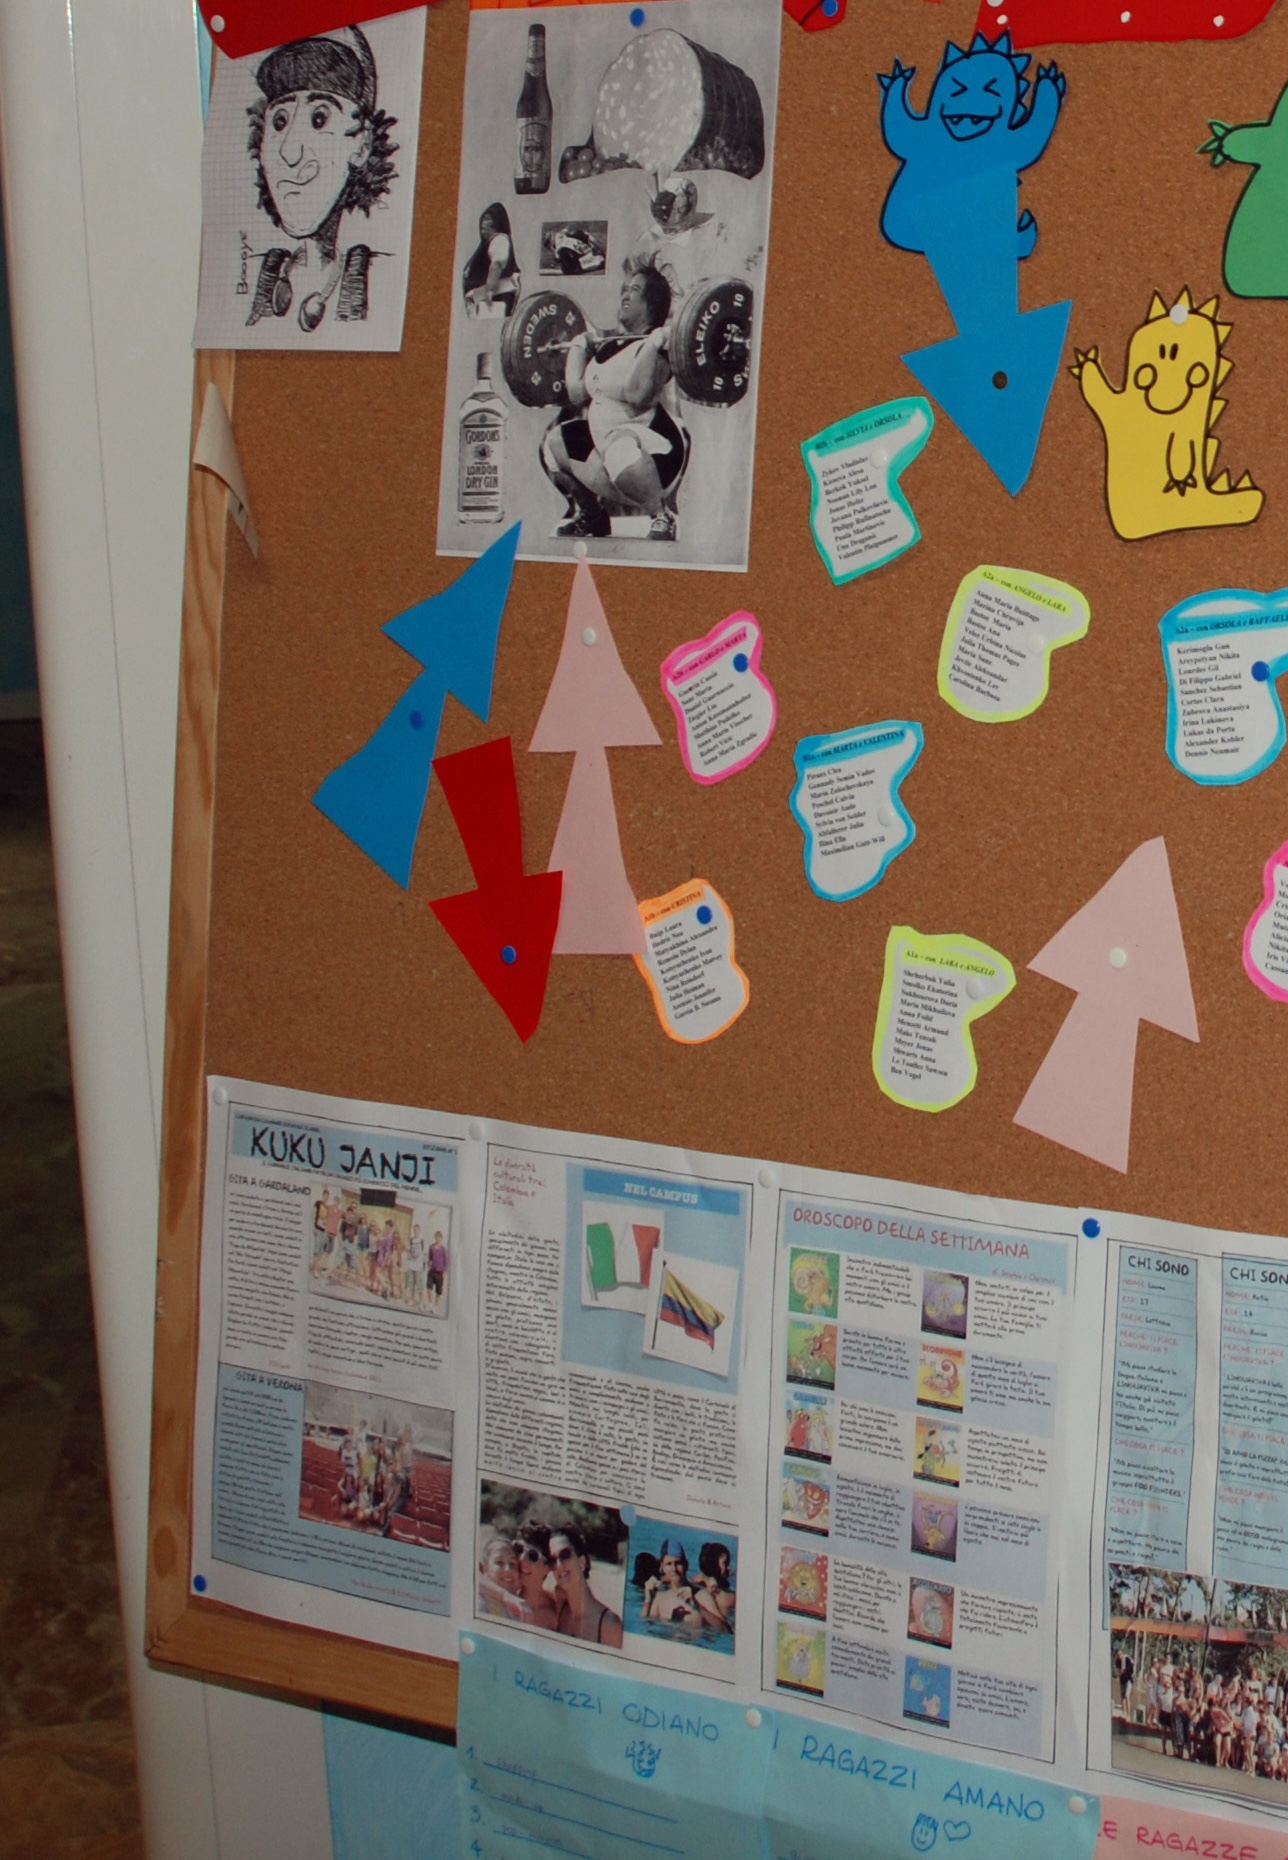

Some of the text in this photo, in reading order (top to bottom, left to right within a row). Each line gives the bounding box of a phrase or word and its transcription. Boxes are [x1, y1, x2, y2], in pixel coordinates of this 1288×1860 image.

[523, 303, 558, 358] SWEDEN
[695, 300, 720, 366] ELEIKO
[465, 476, 499, 489] DRY GIN
[466, 465, 498, 476] LONDON
[228, 1173, 249, 1186] GITA
[258, 1179, 312, 1196] GARDALAND
[339, 1144, 436, 1186] JANJI
[623, 1182, 699, 1205] NEL CAMPUS
[793, 1207, 1030, 1260] OROSCOPO DELLA SETTIMANA
[1127, 1254, 1190, 1277] CHI SONO
[1229, 1266, 1257, 1282] CHI
[514, 1670, 603, 1714] RAGAZZI
[621, 1702, 720, 1742] ODIANO
[799, 1734, 917, 1790] RAGAZZI
[943, 1780, 1046, 1822] AMANO
[1097, 1820, 1260, 1860] E RAGAZZE
